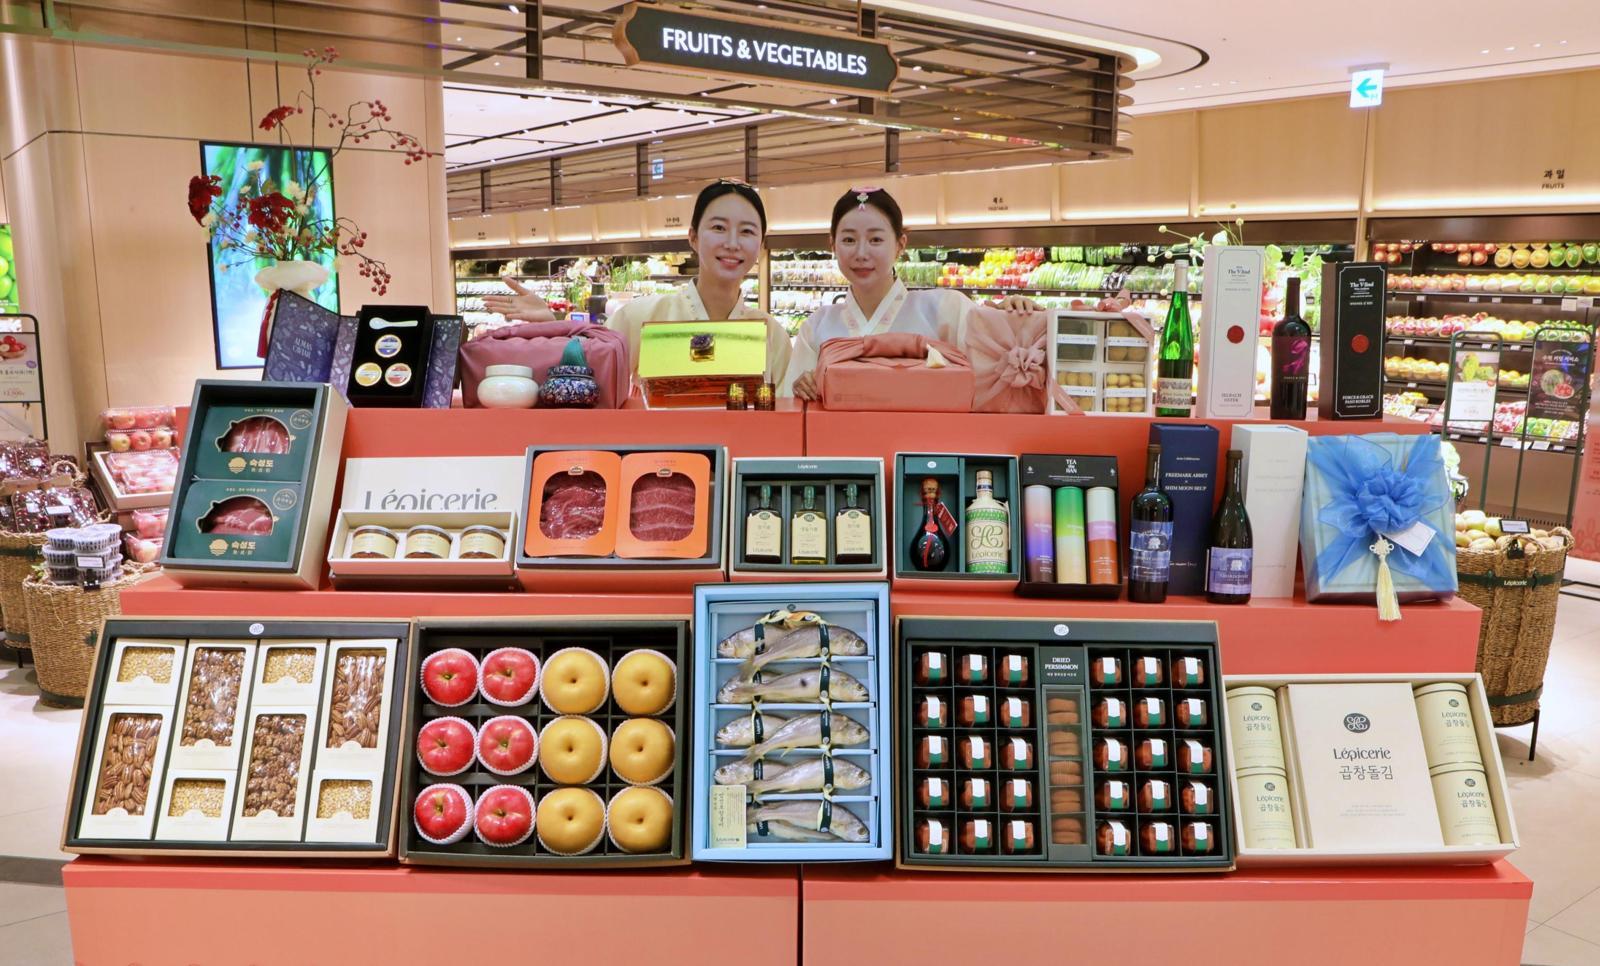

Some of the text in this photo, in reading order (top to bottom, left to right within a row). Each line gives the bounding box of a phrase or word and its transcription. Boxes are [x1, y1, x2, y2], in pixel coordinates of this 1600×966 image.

[662, 27, 867, 76] FRUITS & VEGETABLES
[249, 459, 274, 468] 숙성도
[231, 541, 256, 550] 숙성도
[1333, 746, 1392, 762] Lépicerie
[1339, 765, 1394, 781] 곱창돌김
